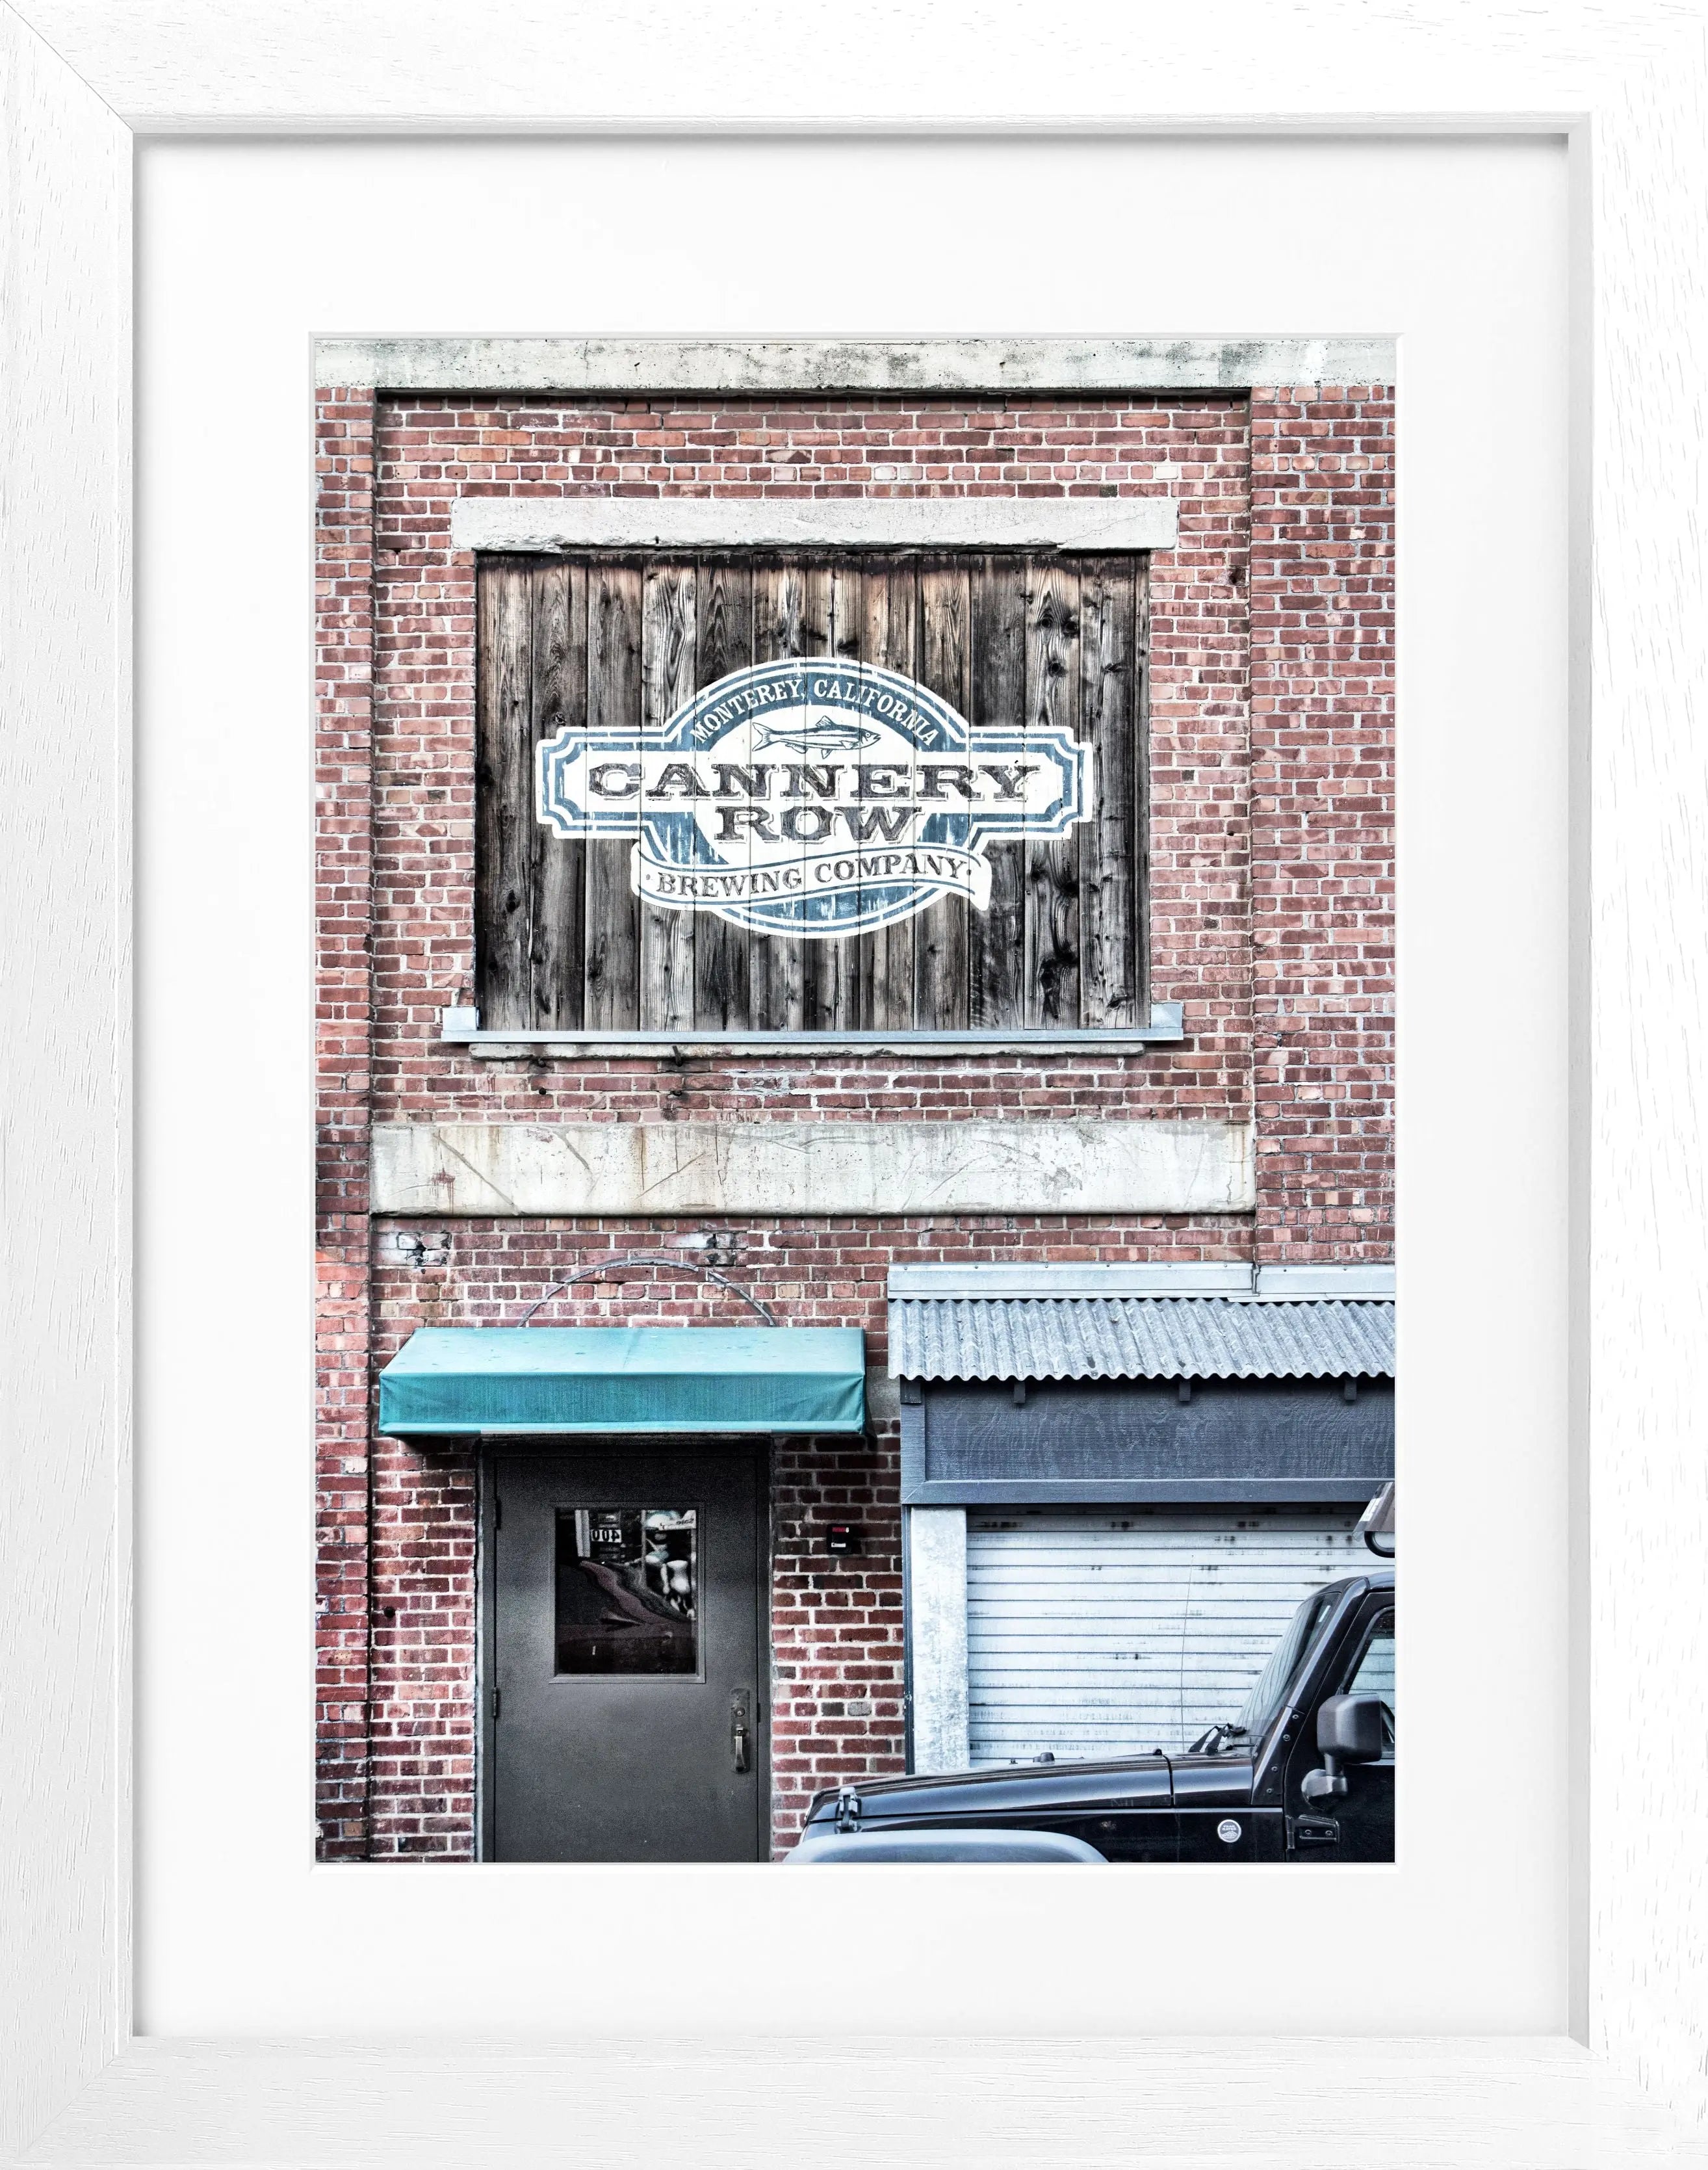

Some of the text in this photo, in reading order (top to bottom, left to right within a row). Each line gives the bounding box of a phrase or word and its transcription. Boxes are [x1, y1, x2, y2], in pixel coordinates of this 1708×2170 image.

[690, 679, 939, 746] MONTEREY, CALIFORNIA
[588, 763, 1041, 801] CANNERY
[714, 805, 925, 844] ROW
[656, 853, 968, 897] BREWING COMPANY
